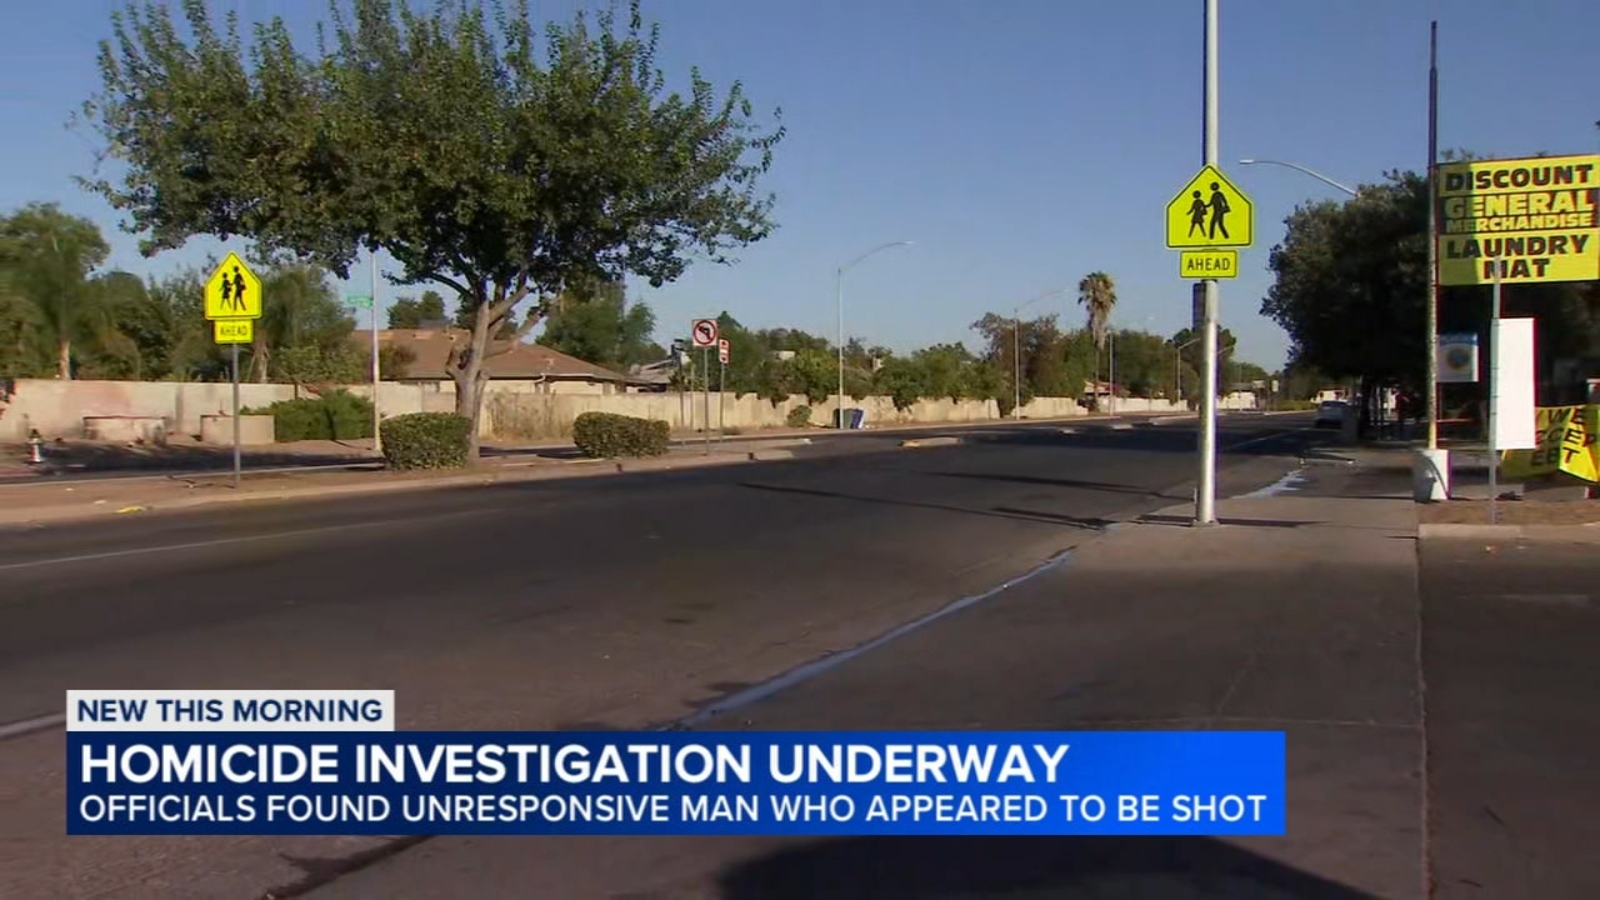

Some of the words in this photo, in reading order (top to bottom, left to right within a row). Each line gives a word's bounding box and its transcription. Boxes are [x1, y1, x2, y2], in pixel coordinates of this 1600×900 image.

[1446, 164, 1593, 191] DISCOUNT
[1445, 190, 1594, 219] GENERAL
[1446, 213, 1592, 233] MERCHANDISE
[1446, 234, 1589, 259] LAUNDRY
[1186, 257, 1231, 271] AHEAD
[1483, 258, 1550, 280] MAT
[219, 324, 248, 337] AHEAD
